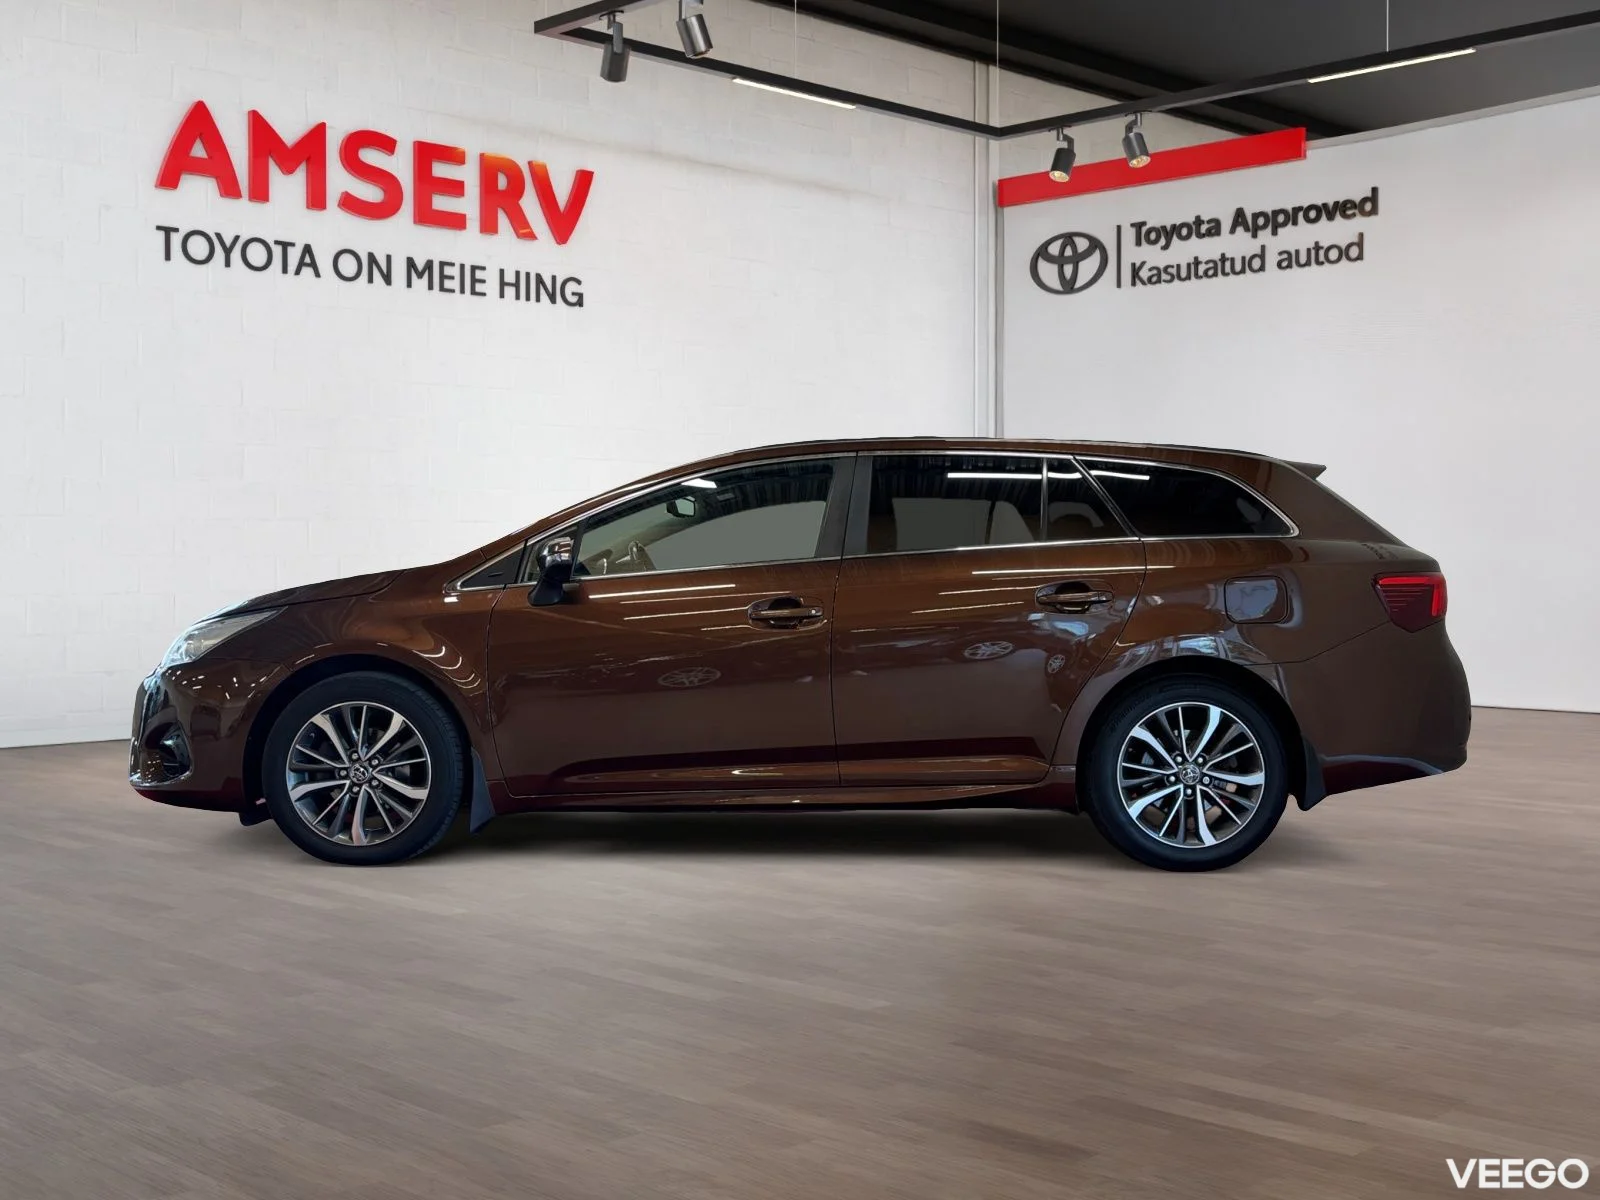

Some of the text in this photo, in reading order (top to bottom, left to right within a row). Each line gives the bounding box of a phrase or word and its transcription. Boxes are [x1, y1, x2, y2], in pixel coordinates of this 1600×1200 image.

[155, 99, 595, 245] AMSERV
[1130, 186, 1379, 250] Toyota Approved
[155, 225, 584, 307] TOYOTA ON MEIE HING
[1130, 232, 1365, 288] Kasutatud autod
